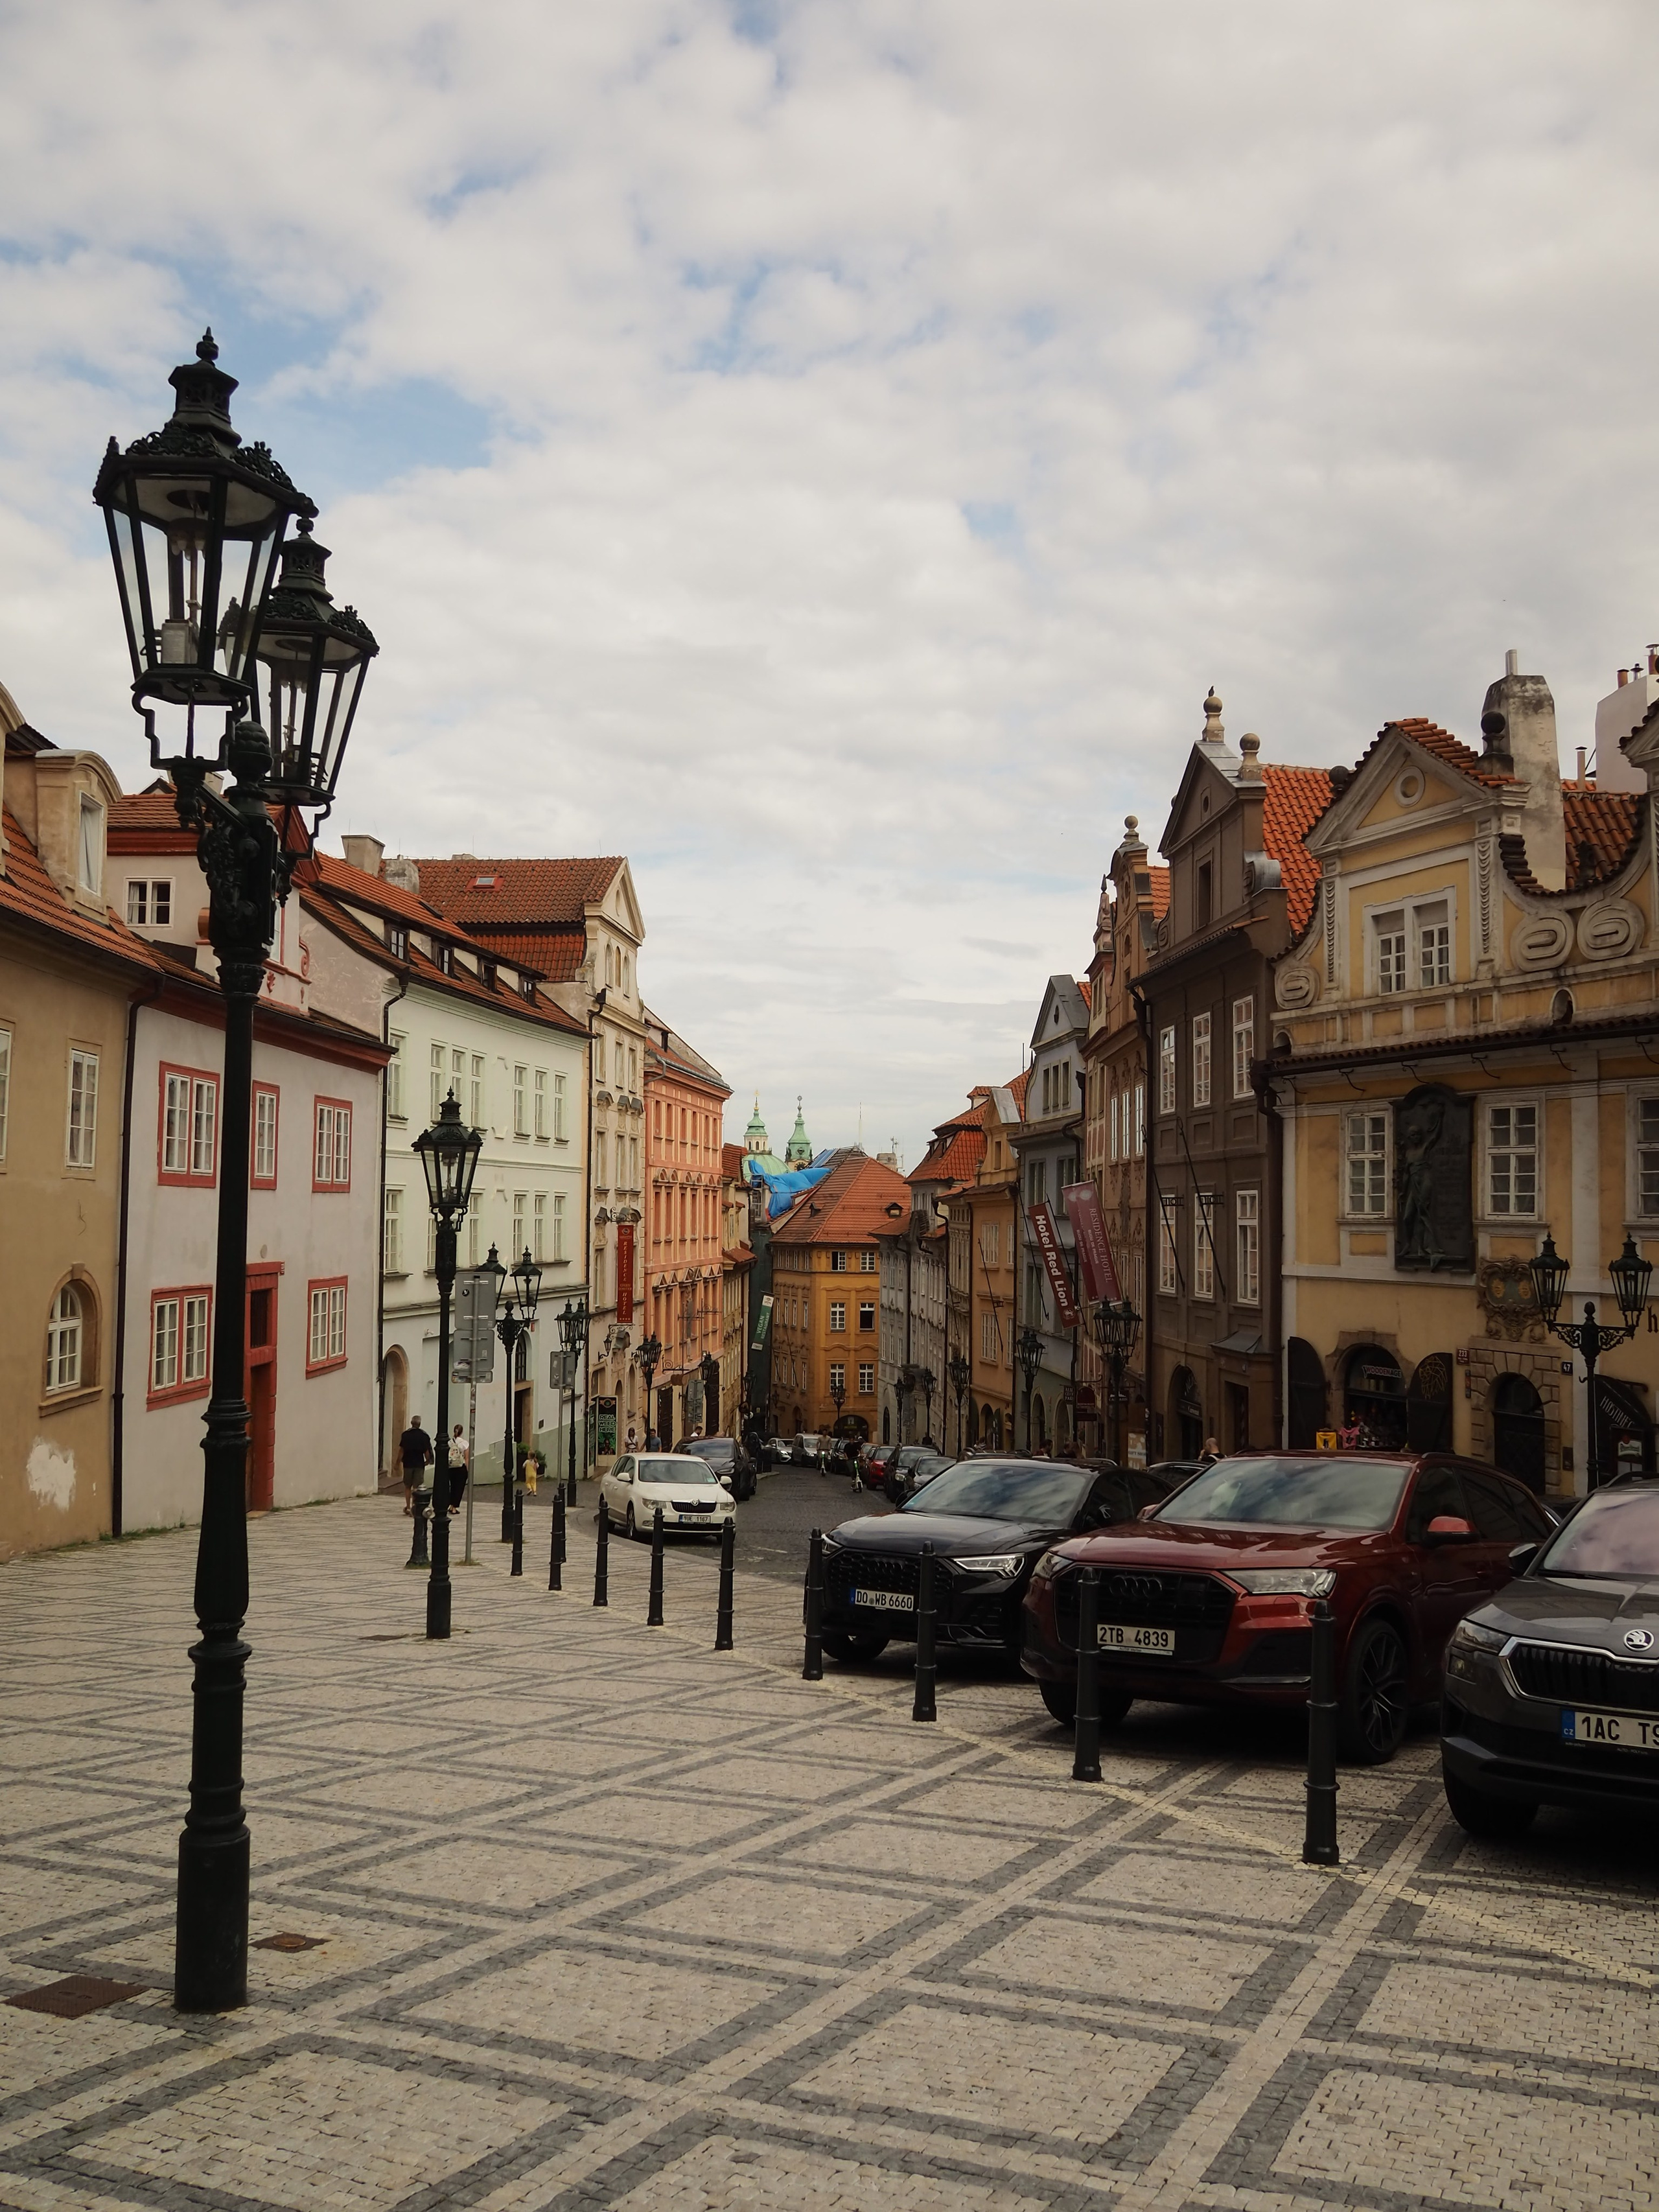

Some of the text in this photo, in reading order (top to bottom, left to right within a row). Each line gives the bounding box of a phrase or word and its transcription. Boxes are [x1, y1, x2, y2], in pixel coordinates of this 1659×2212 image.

[1089, 1208, 1113, 1283] RESIDENCE HOTEL
[1035, 1215, 1069, 1307] Hotel Red Lion
[760, 1312, 771, 1339] RESTAURANT
[1563, 1364, 1570, 1372] 47
[856, 1590, 912, 1609] DO WB 6660
[1099, 1627, 1168, 1647] 2TB 4839
[1582, 1716, 1619, 1740] 1AC
